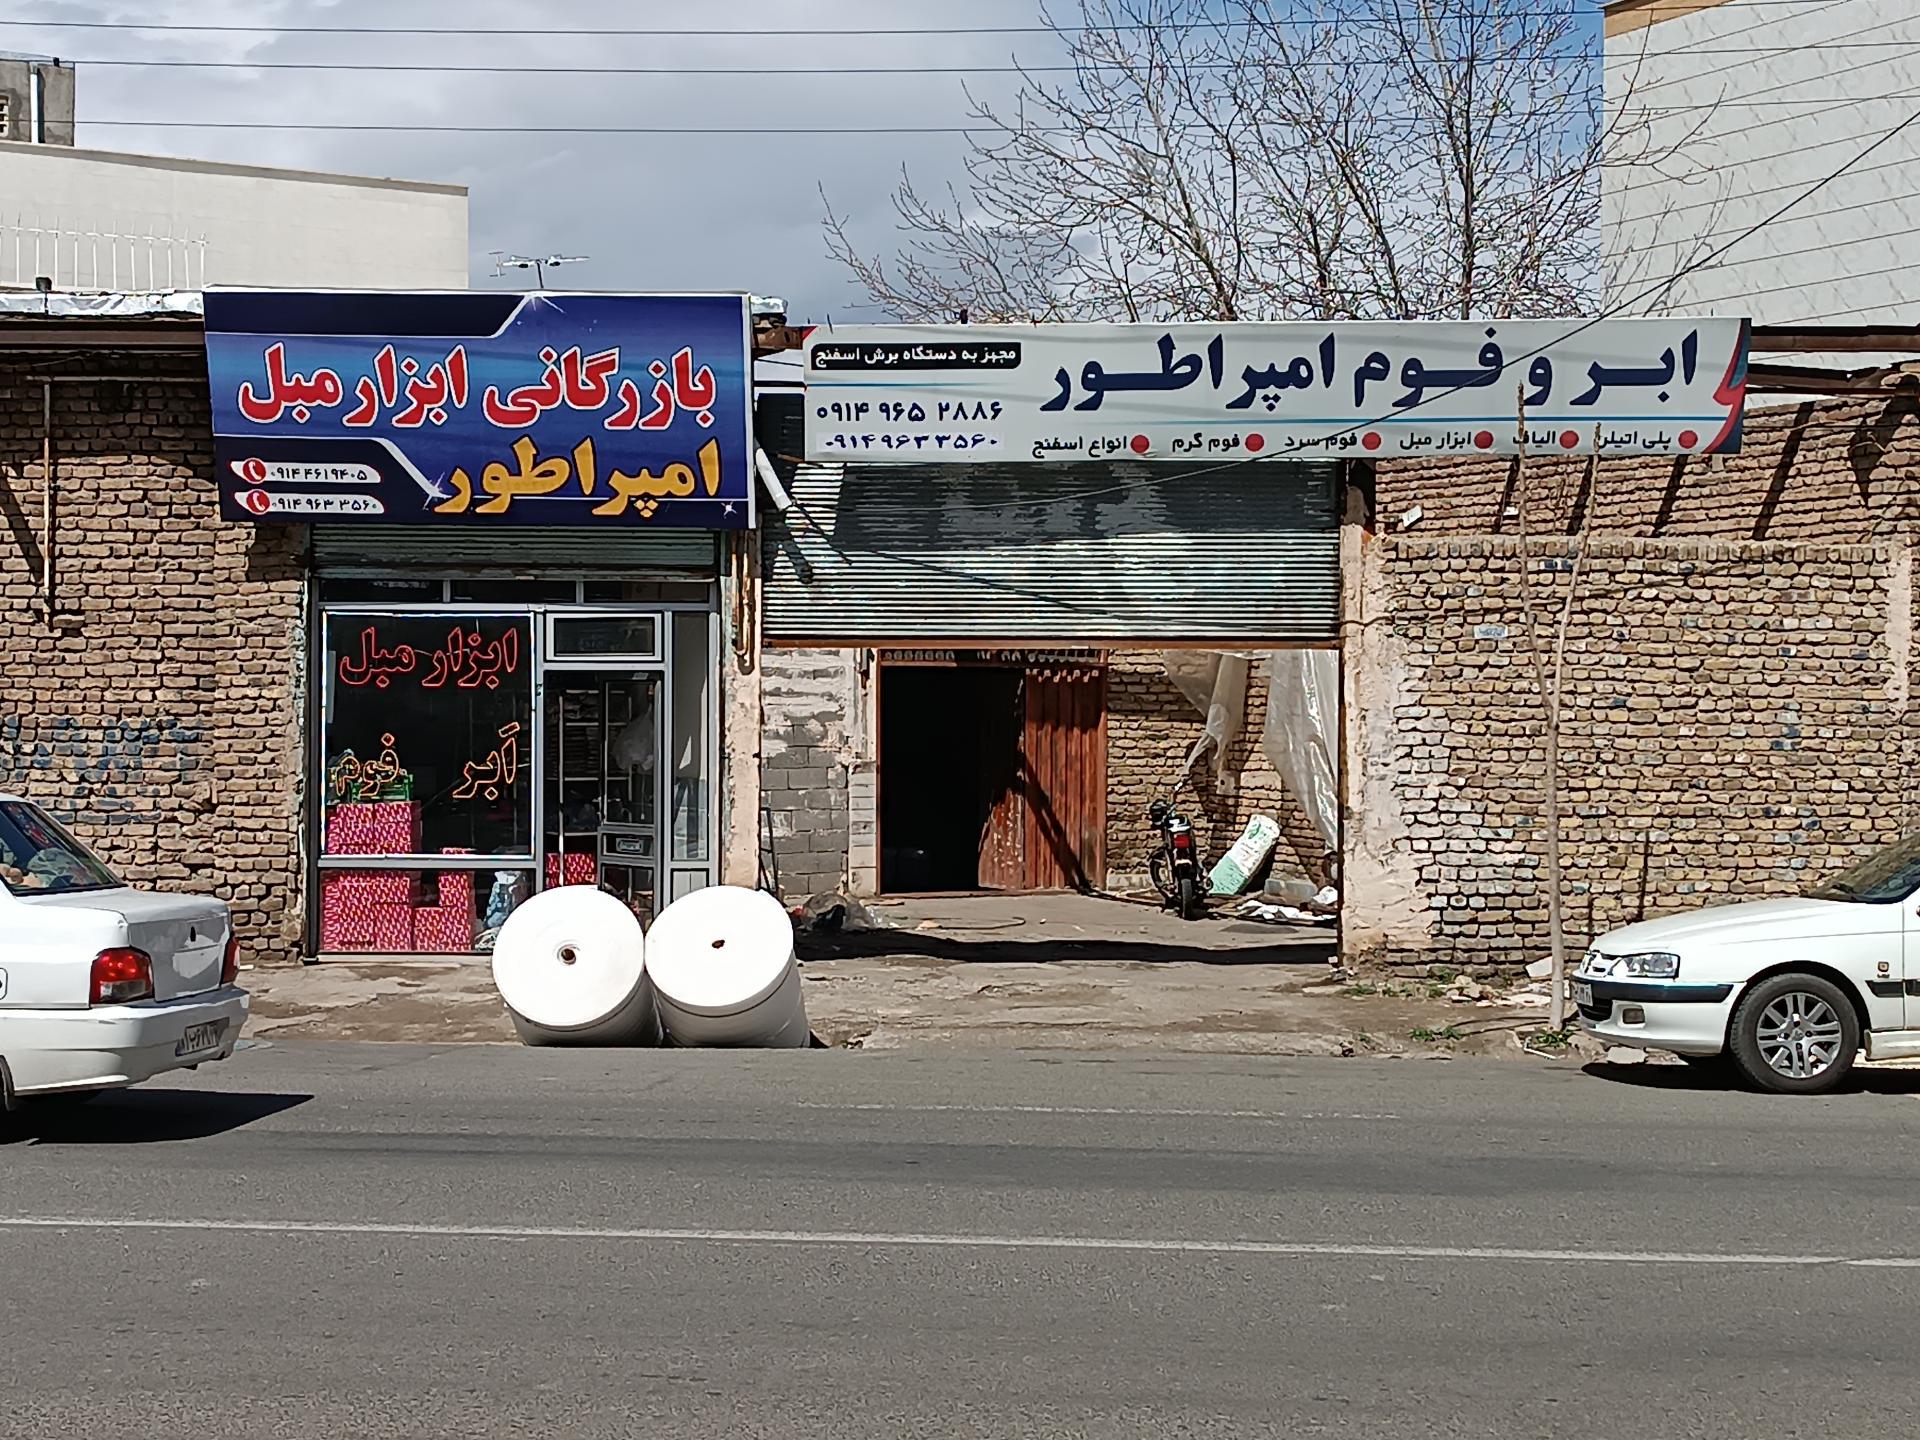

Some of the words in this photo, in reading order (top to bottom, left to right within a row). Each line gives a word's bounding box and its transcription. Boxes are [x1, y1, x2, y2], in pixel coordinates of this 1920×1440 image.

[815, 347, 860, 369] اسفنج
[865, 347, 899, 365] برش
[903, 346, 957, 361] دستگاه
[962, 350, 977, 364] به
[981, 346, 1016, 363] مجهز
[1354, 327, 1503, 408] فوم
[1569, 328, 1698, 406] ابر
[238, 341, 343, 424] مبل
[342, 344, 470, 428] ابزار
[483, 345, 718, 431] بازرگانی
[1523, 356, 1553, 406] و
[816, 402, 870, 422] ۰۹۱۴
[879, 402, 925, 422] ۹۶۵
[938, 401, 1003, 422] ۲۸۸۶
[1031, 436, 1083, 459] اسفنج
[1088, 436, 1127, 457] انواع
[1172, 433, 1202, 452] گرم
[1208, 434, 1240, 452] فوم
[1325, 433, 1358, 450] فوم
[1400, 432, 1432, 449] مبل
[1435, 431, 1471, 450] ابزار
[1512, 431, 1556, 447] الیاف
[1642, 431, 1671, 450] پلی
[339, 627, 416, 687] مبل
[421, 626, 518, 688] ابزار
[335, 732, 400, 797] فوم
